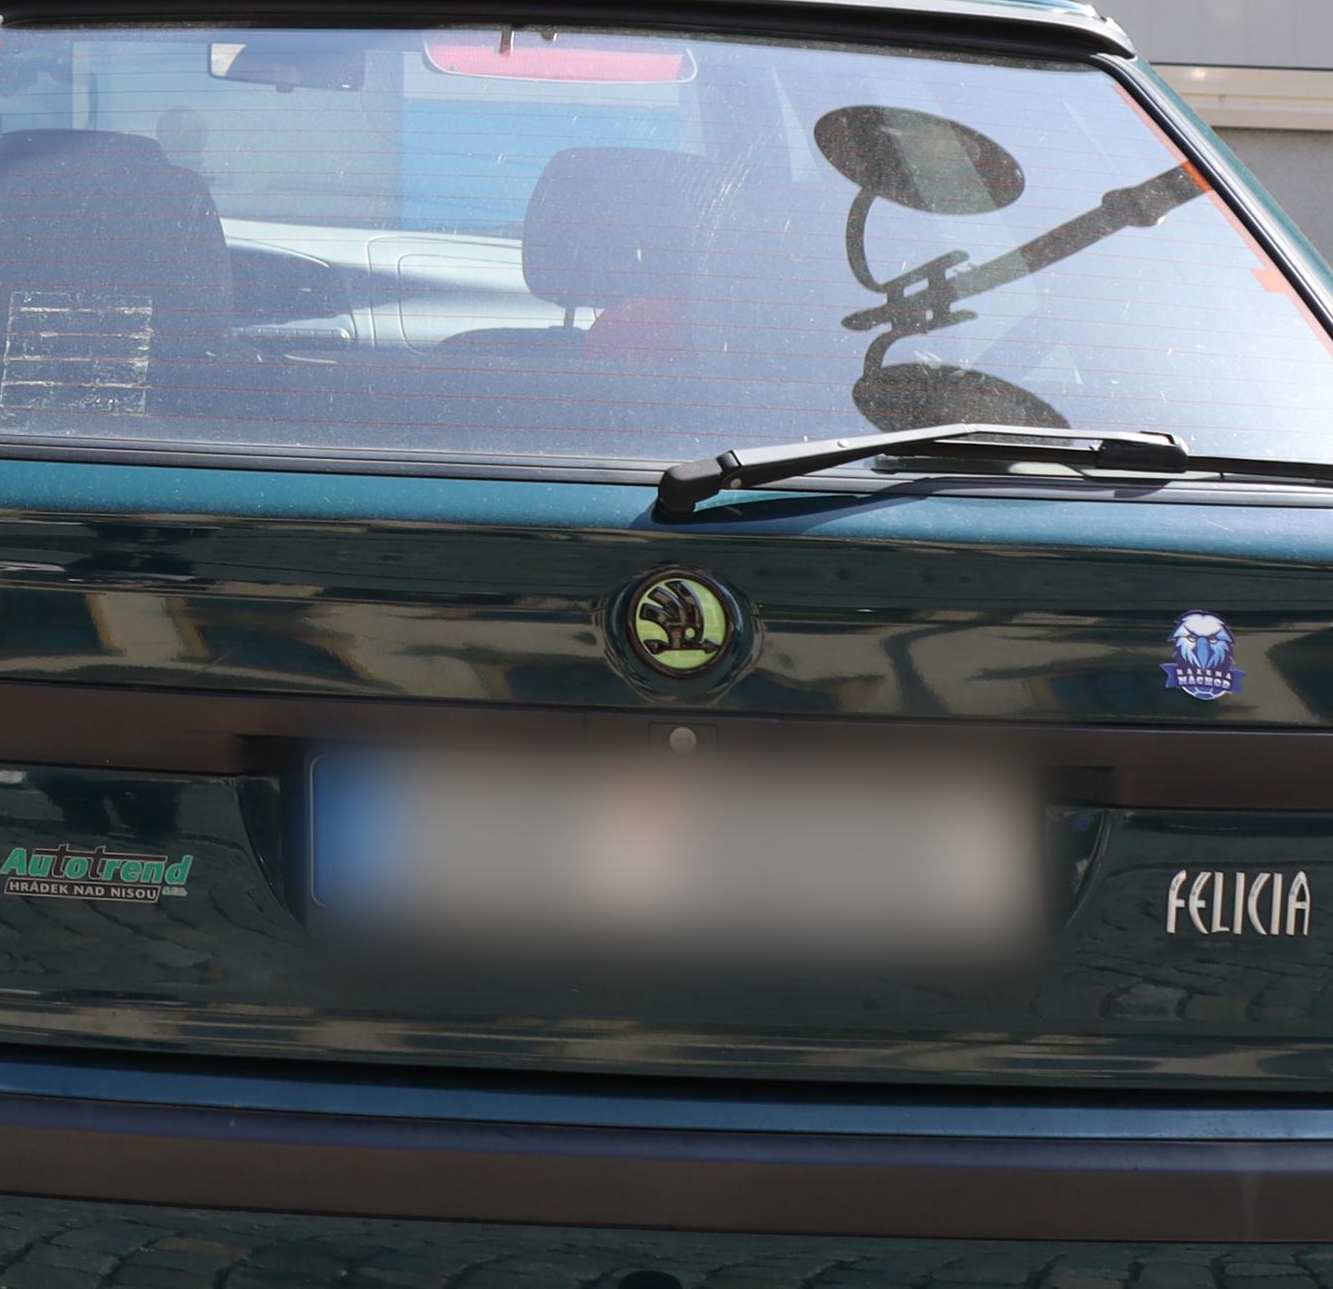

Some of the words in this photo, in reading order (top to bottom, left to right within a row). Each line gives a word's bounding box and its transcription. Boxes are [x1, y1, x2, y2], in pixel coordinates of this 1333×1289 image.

[0, 844, 194, 885] Autotrend
[8, 880, 70, 895] HRÁDEK
[72, 883, 108, 897] NAD
[110, 886, 157, 900] NISOU
[1165, 869, 1311, 936] FELICIA
